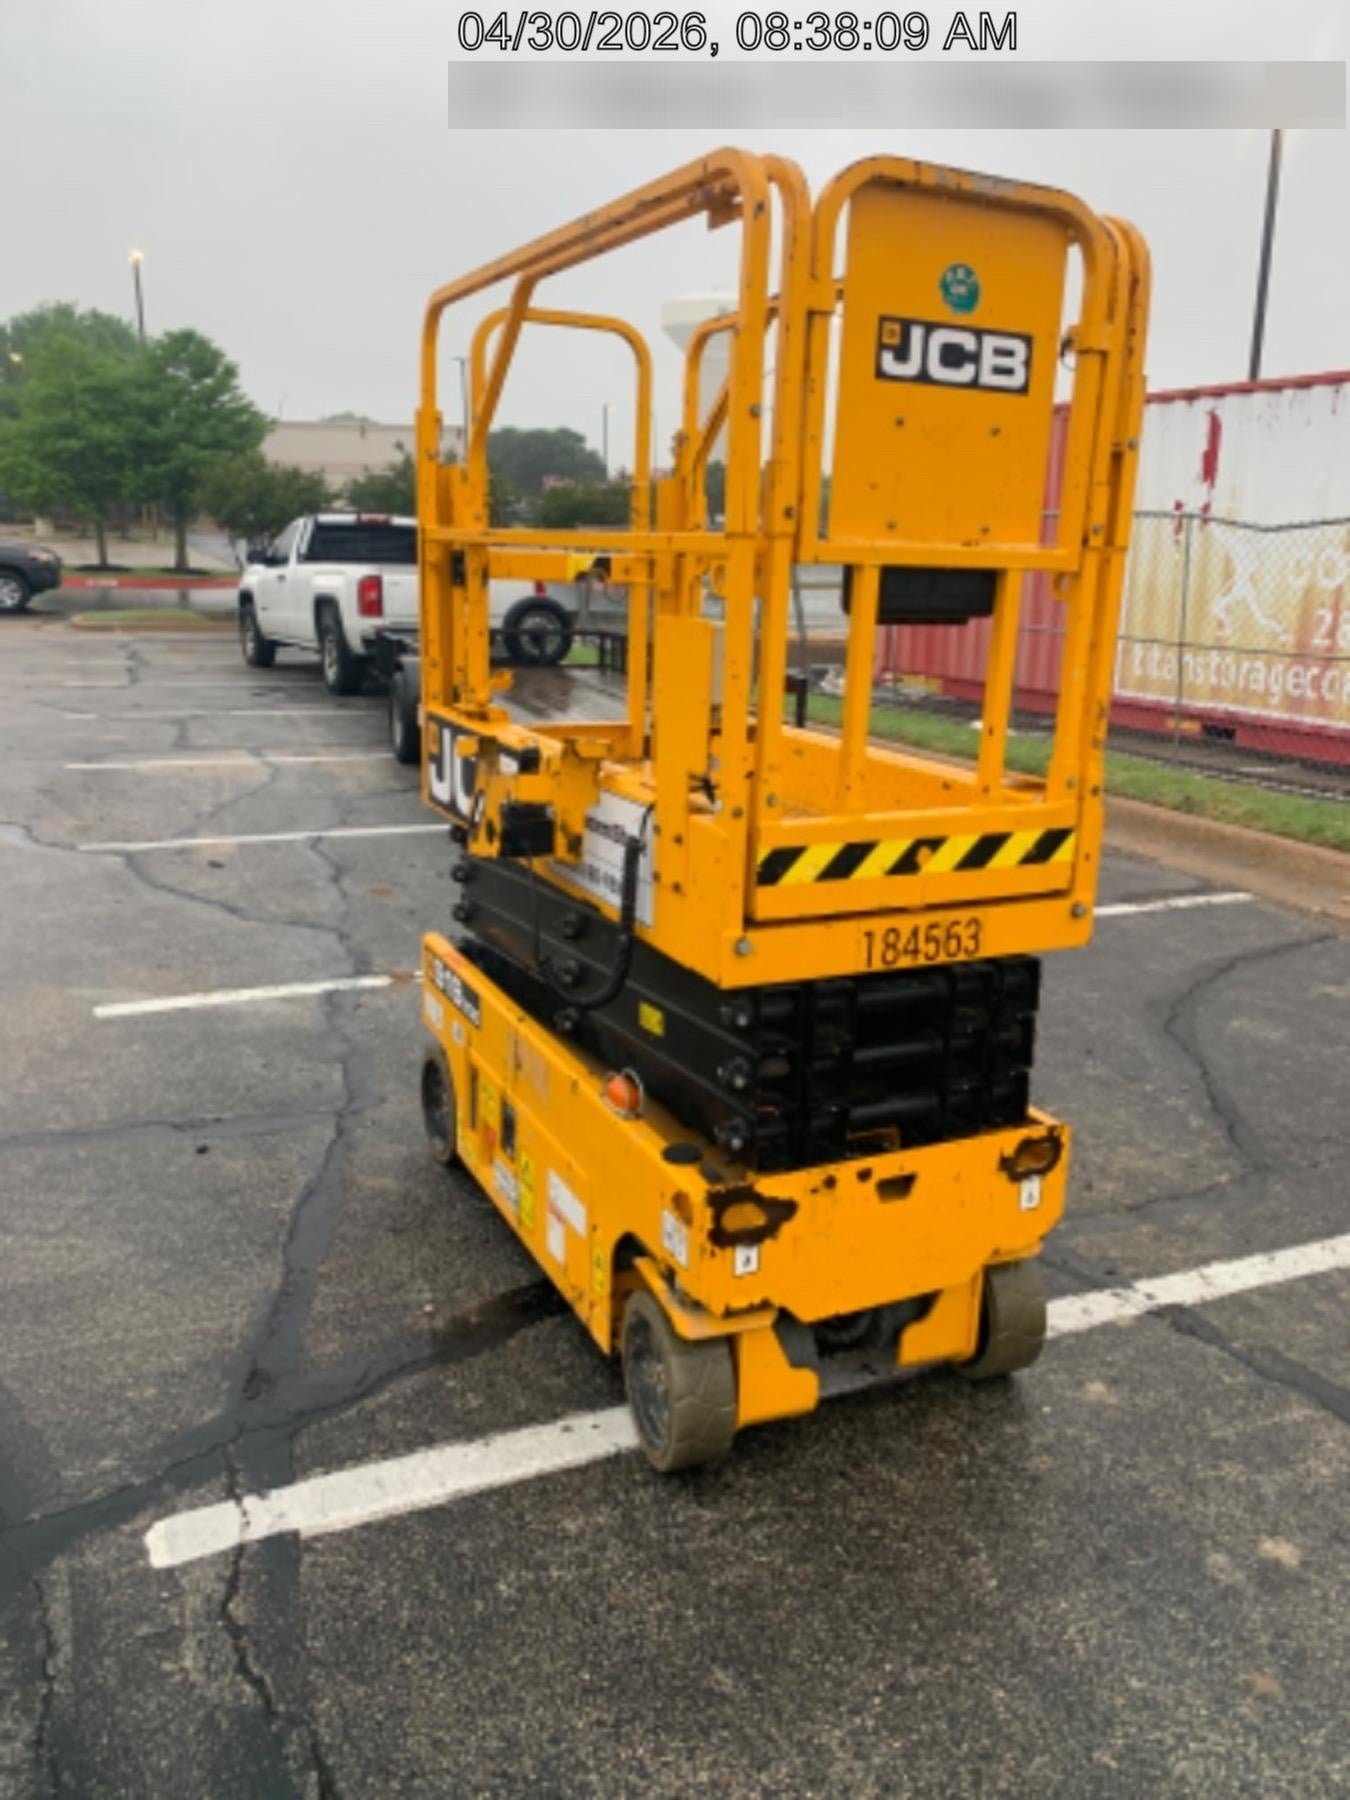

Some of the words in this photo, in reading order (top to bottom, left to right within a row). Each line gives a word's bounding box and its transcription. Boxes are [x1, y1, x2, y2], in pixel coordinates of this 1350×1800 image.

[880, 323, 1029, 390] JCB
[430, 727, 518, 824] JC
[863, 917, 981, 968] 184563
